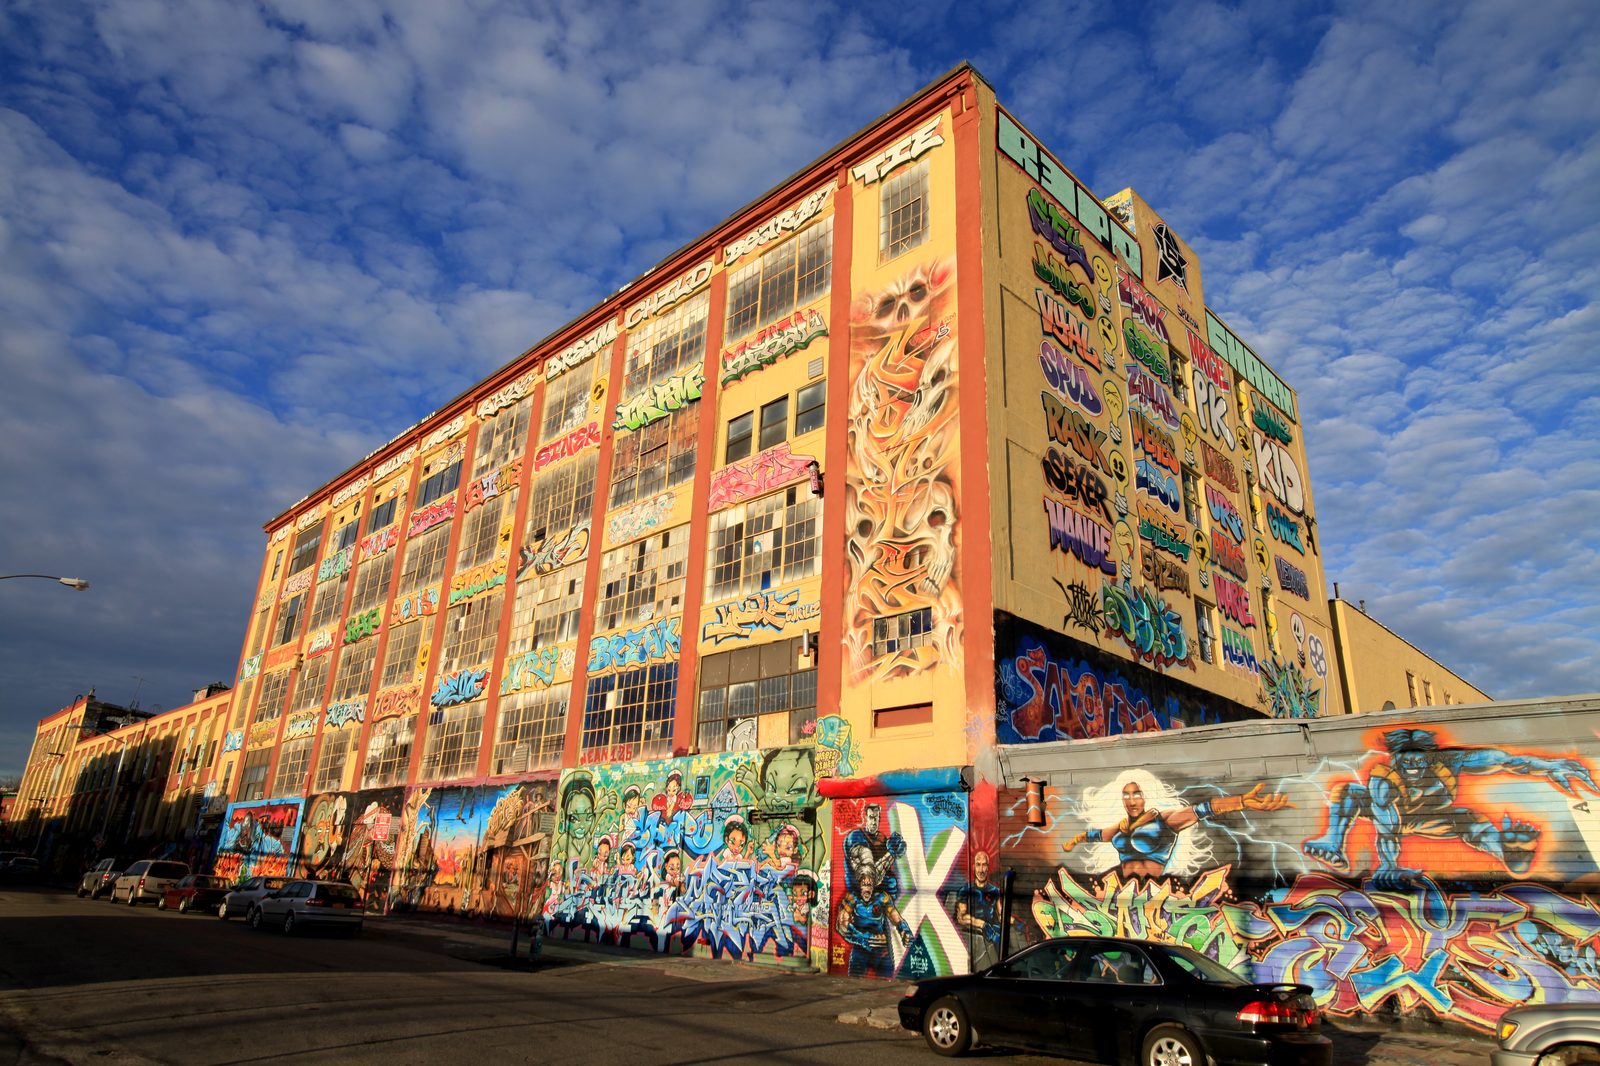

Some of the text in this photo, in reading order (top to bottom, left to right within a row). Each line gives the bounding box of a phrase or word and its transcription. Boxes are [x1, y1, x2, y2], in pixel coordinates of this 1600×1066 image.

[853, 113, 945, 185] TIE
[623, 259, 713, 330] CHILD
[1035, 288, 1103, 374] VYAL
[545, 317, 618, 381] DREAM
[1039, 340, 1103, 417] SPUD
[1040, 390, 1113, 479] RASK
[1192, 367, 1235, 451] PK
[1252, 430, 1304, 518] KID
[586, 616, 682, 674] BREAK
